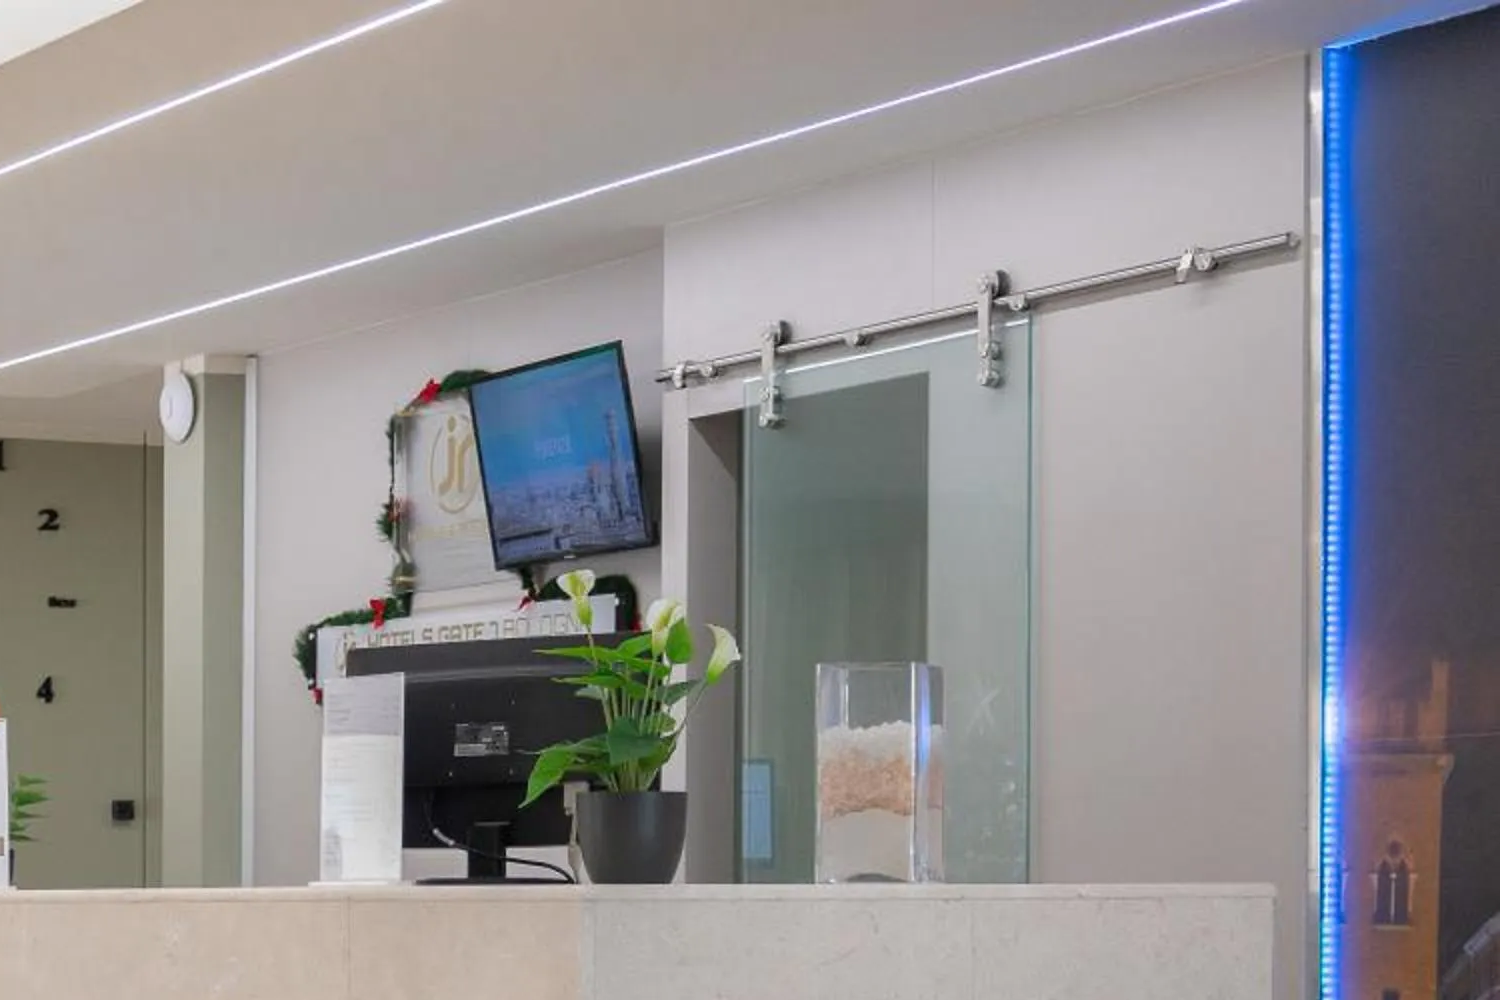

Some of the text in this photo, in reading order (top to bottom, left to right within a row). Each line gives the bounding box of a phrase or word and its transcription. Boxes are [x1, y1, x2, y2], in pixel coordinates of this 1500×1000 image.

[37, 509, 60, 531] 2
[438, 621, 485, 643] GATE
[36, 677, 55, 703] 4
